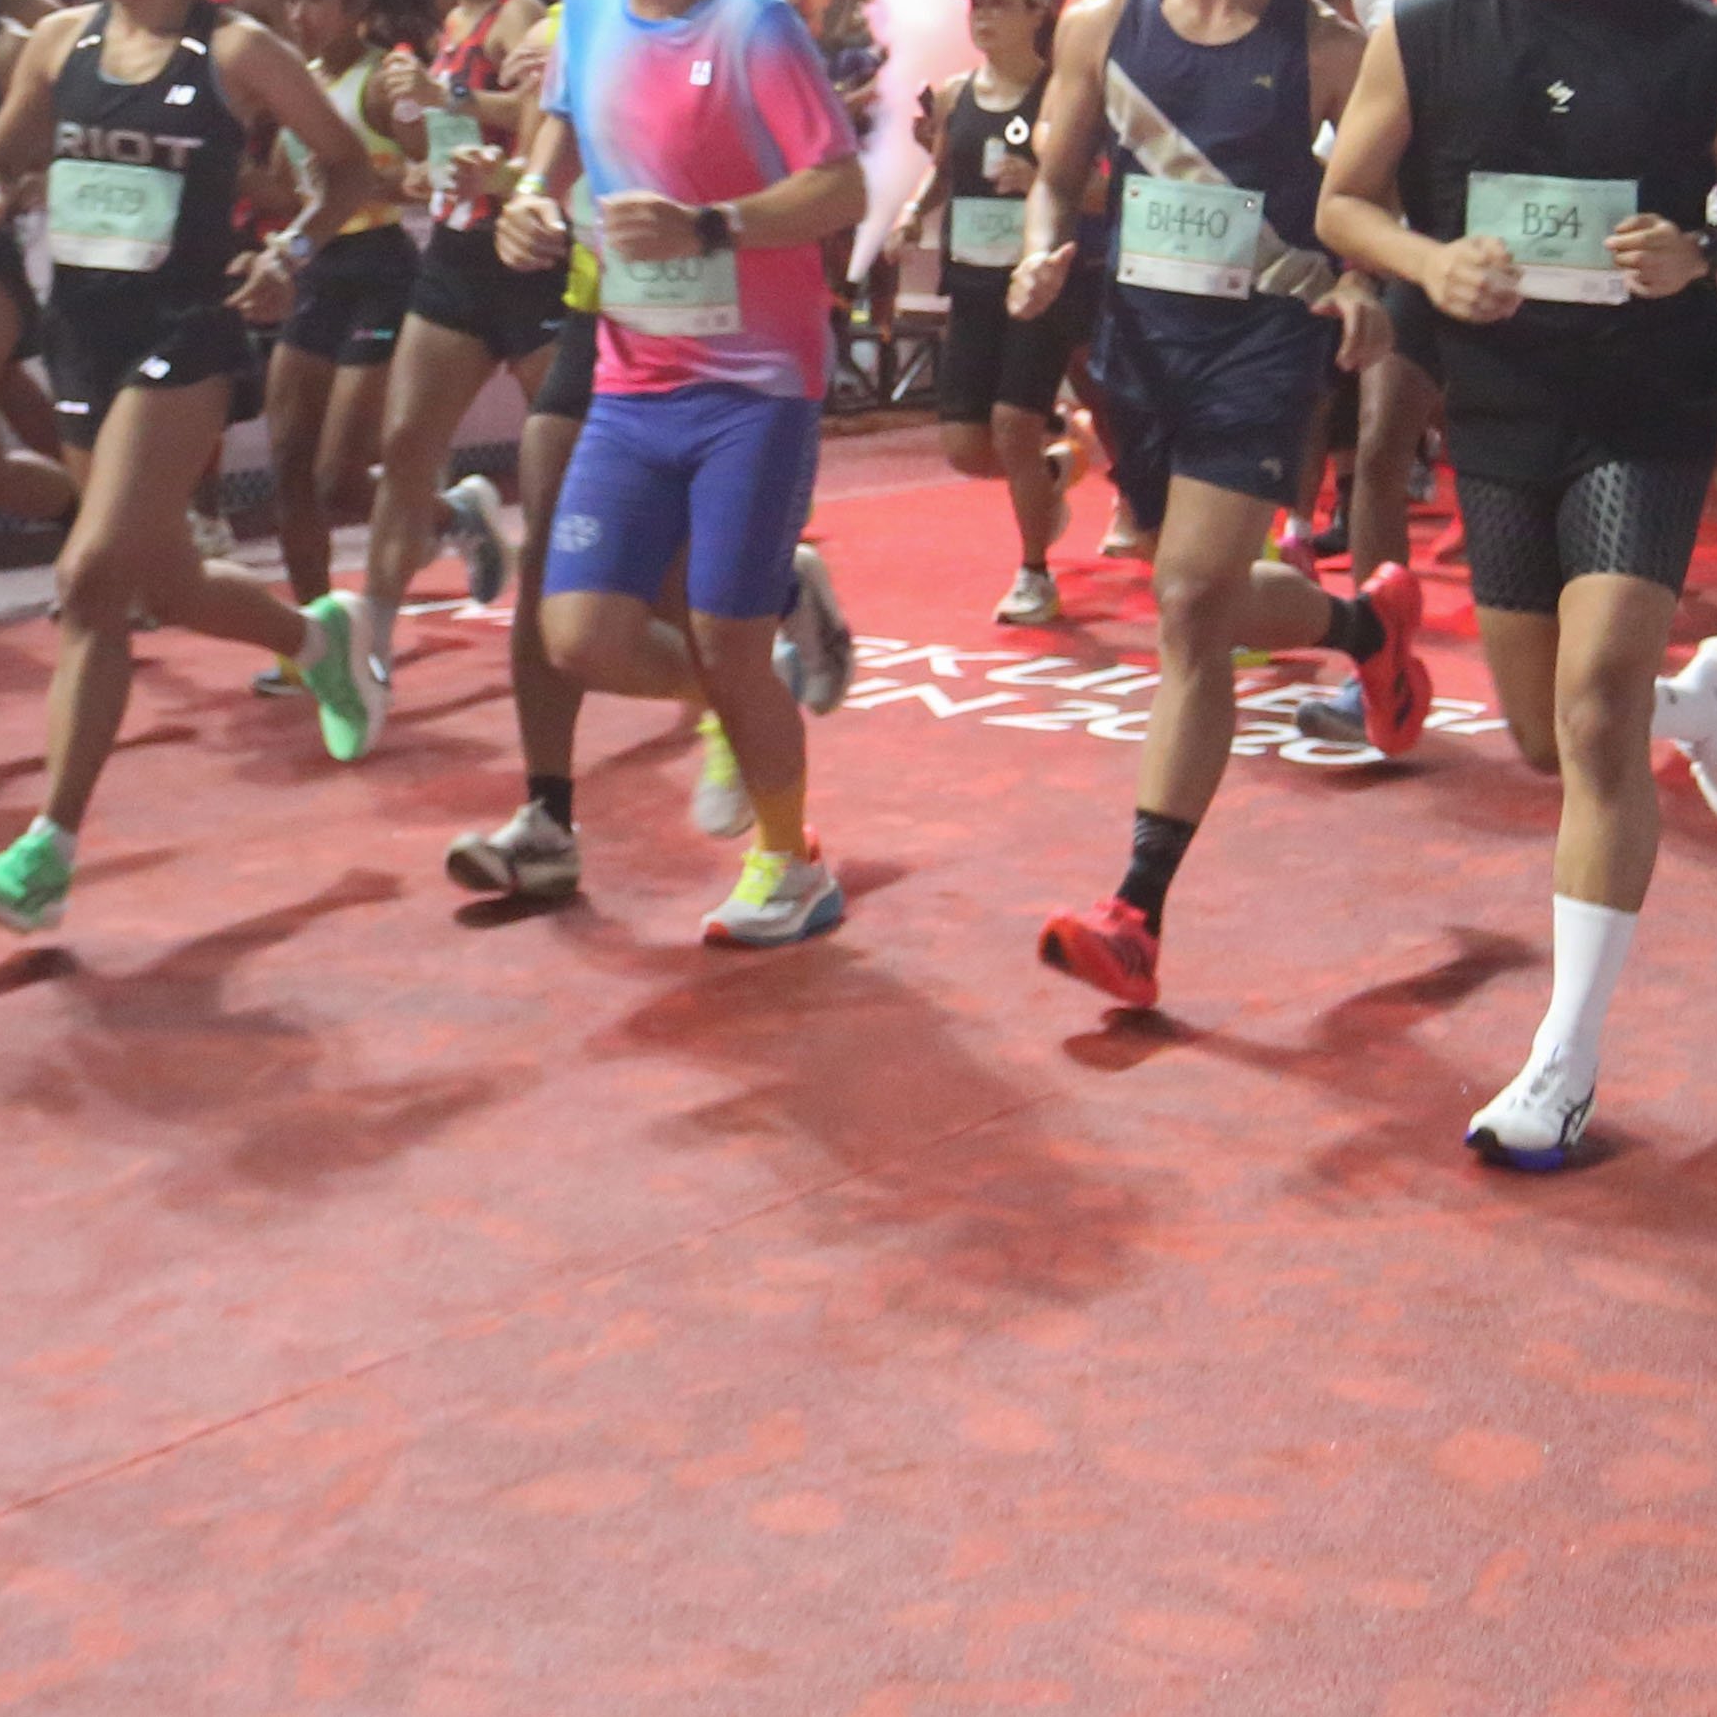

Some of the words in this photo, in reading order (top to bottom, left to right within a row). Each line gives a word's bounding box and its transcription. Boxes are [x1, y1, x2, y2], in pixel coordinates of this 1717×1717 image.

[54, 120, 205, 171] RIOT
[1146, 200, 1229, 240] B1440
[1522, 201, 1583, 239] B54
